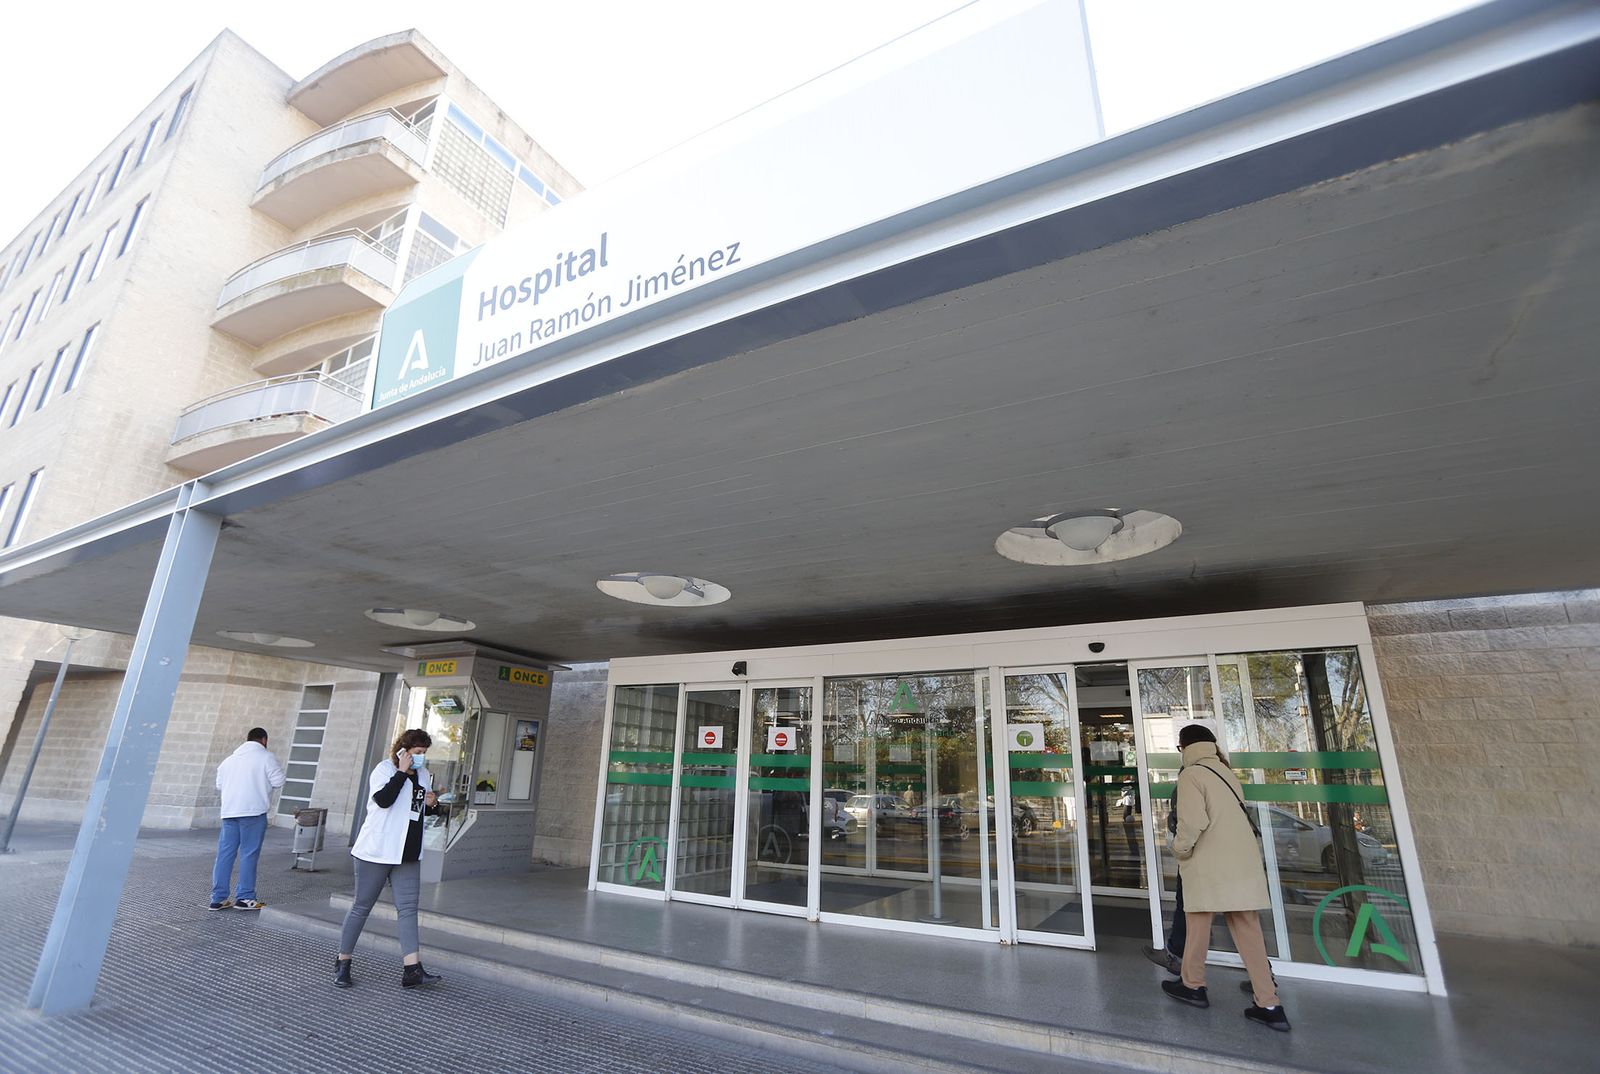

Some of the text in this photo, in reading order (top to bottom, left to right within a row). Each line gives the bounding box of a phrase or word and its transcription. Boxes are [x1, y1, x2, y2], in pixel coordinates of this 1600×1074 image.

[478, 231, 608, 322] Hospital
[473, 241, 741, 367] Juan Ramón Jiménez
[377, 365, 447, 403] Junta de Andalucía
[429, 661, 454, 674] ONCE
[513, 670, 545, 685] ONCE
